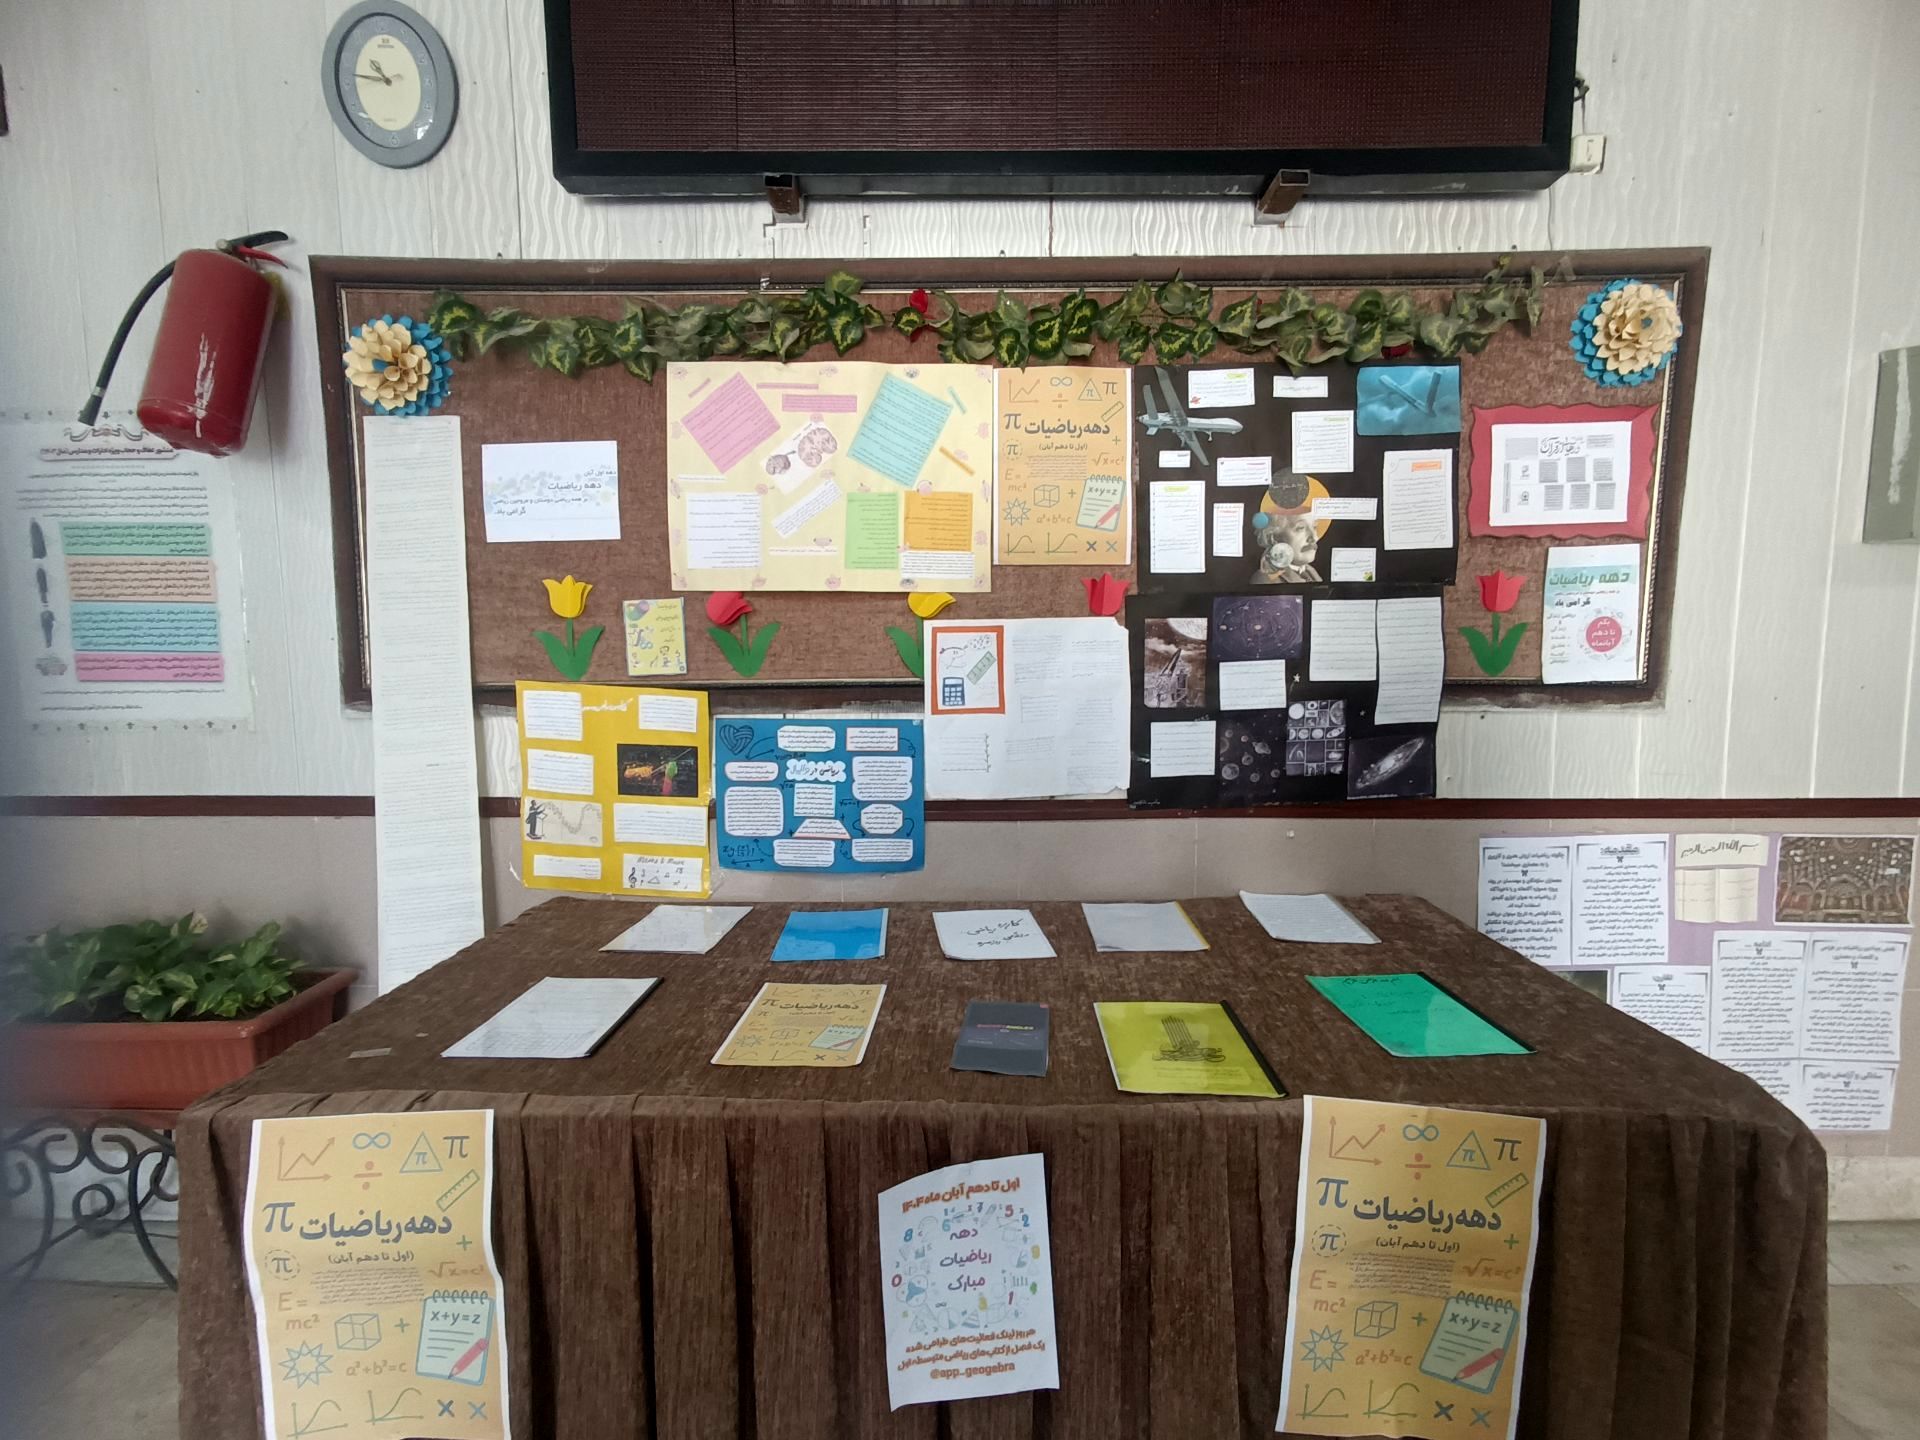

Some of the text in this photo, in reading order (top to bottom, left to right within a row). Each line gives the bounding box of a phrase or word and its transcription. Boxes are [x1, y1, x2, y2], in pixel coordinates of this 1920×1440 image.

[1103, 381, 1118, 395] π
[1004, 413, 1022, 430] π
[1025, 418, 1110, 439] دهه ریاضیات
[547, 480, 583, 492] ریاضیات
[1549, 572, 1631, 588] دهه ریاضیات
[1591, 630, 1609, 638] دهم
[779, 1000, 834, 1011] ریاضیات
[416, 1135, 470, 1165] π π
[1462, 1138, 1522, 1162] π π
[942, 1182, 966, 1202] آبان
[966, 1182, 991, 1200] دهم
[991, 1180, 1000, 1191] تا
[1001, 1177, 1021, 1193] اول
[1316, 1177, 1349, 1208] π
[924, 1190, 942, 1204] ماه
[262, 1201, 296, 1233] π
[1004, 1204, 1014, 1218] 5
[1353, 1195, 1502, 1234] دهه ریاضیات
[299, 1209, 453, 1247] دهه ریاضیات
[942, 1218, 951, 1232] 6
[1021, 1214, 1030, 1228] 2
[903, 1228, 914, 1242] 8
[950, 1228, 979, 1241] دهه
[1319, 1233, 1341, 1251] π
[1375, 1236, 1461, 1252] (اول تا دهم آبان)
[328, 1250, 415, 1265] (اول تا دهم آبان)
[939, 1248, 993, 1268] ریاضیات
[271, 1257, 294, 1274] π
[947, 1275, 986, 1292] مبارک
[996, 1328, 1016, 1340] لینک
[905, 1341, 924, 1353] شده
[923, 1337, 949, 1350] طراحی
[1011, 1341, 1033, 1355] فصل
[1032, 1339, 1046, 1351] یک
[944, 1349, 970, 1361] ریاضی
[930, 1361, 1016, 1380] @app_geogebra
